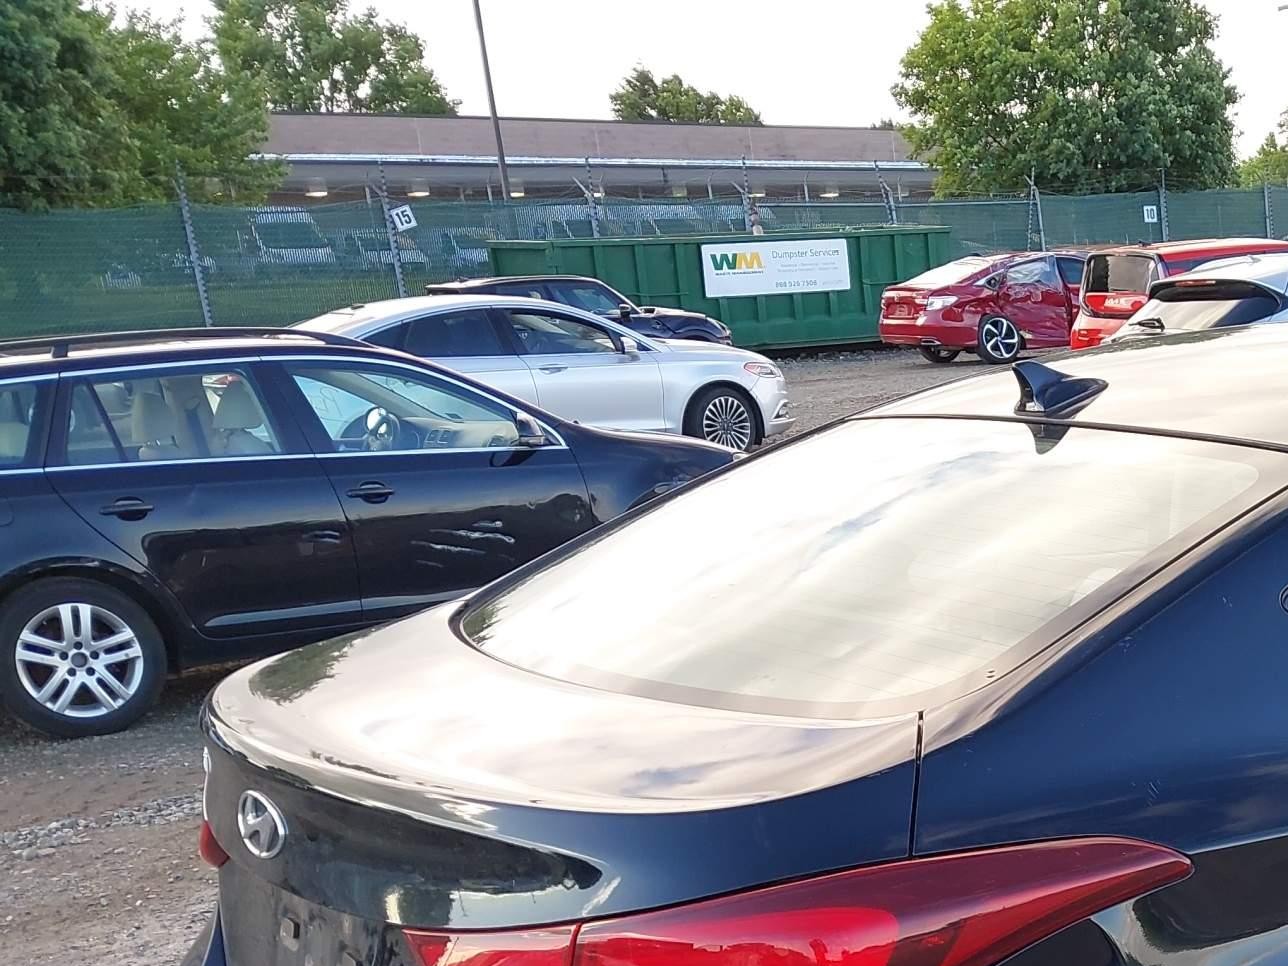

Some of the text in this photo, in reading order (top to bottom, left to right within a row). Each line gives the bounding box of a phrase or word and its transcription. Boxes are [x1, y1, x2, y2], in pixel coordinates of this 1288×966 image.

[395, 209, 413, 227] 15
[1145, 208, 1155, 220] 10
[710, 252, 763, 271] WM
[771, 248, 840, 260] Dumpster Services
